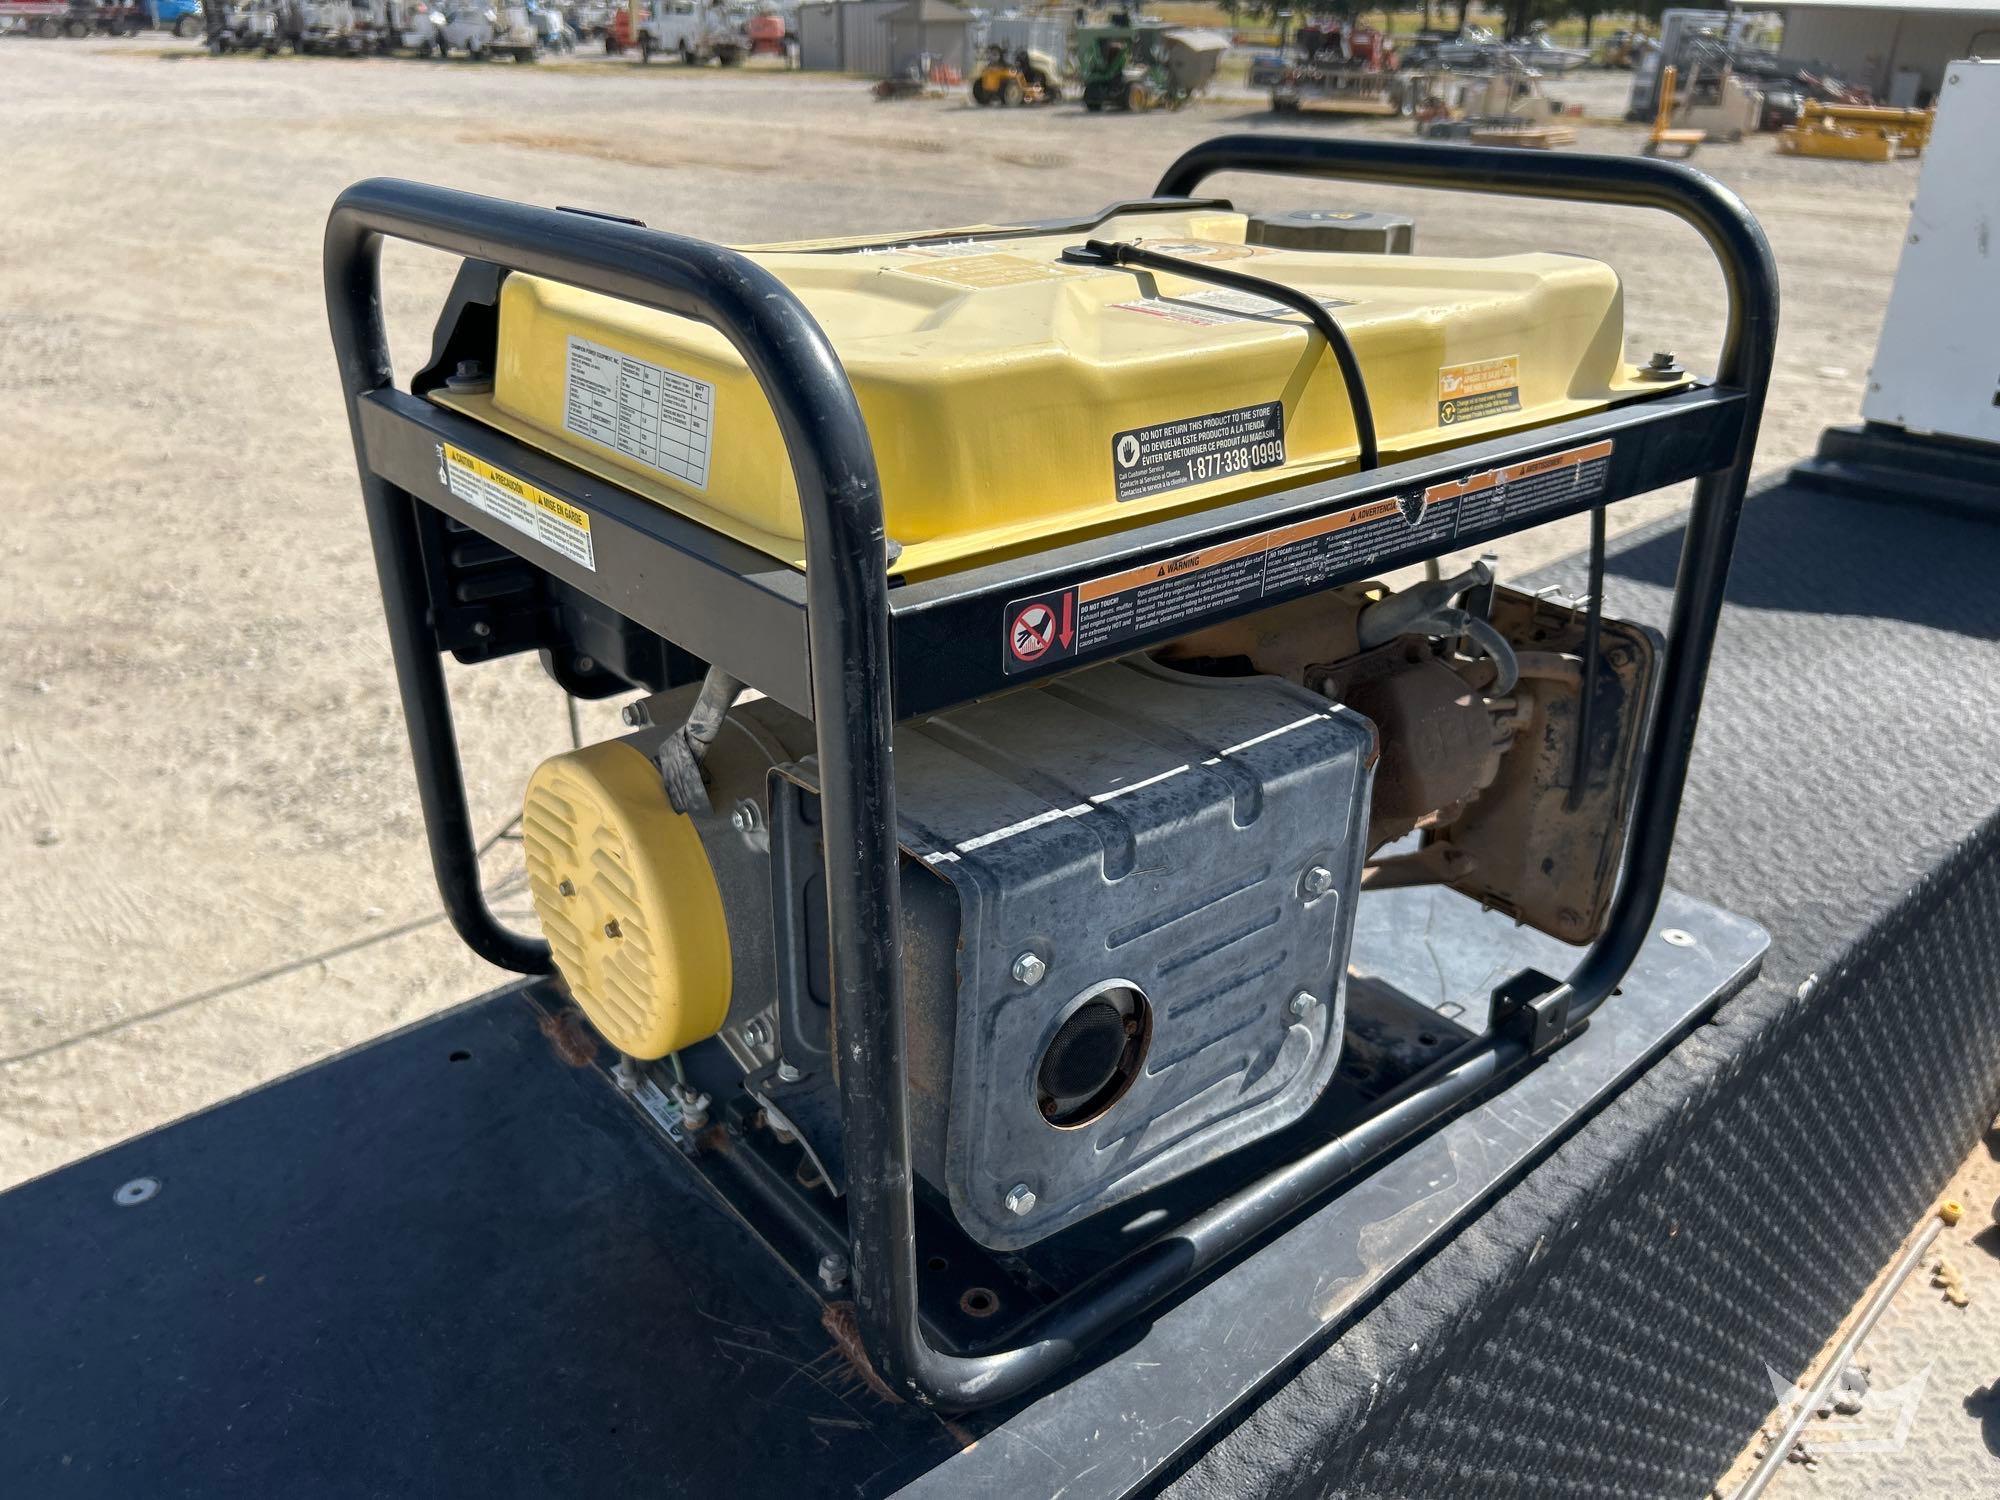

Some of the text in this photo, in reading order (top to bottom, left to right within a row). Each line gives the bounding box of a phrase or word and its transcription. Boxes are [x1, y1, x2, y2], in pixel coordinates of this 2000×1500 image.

[1140, 431, 1150, 441] DO
[1150, 428, 1162, 439] NOT
[1164, 423, 1188, 436] RETURN
[1189, 420, 1202, 431] THIS
[1203, 415, 1230, 428] PRODUCT
[1231, 413, 1239, 423] TO
[1240, 410, 1251, 421] THE
[1252, 406, 1270, 418] STORE
[1141, 419, 1264, 453] NO DEVUELVA ESTE PRODUCTO A LA TIENDA
[1142, 429, 1274, 465] ÉVITER DE RETOURNER CE PRODUIT AU MAGASIN
[1186, 439, 1283, 481] 1-877-338-0999
[1118, 464, 1164, 480] Call Customer Service
[1357, 499, 1396, 520] ADVERTENCIA
[1167, 556, 1199, 574] WARNING
[1137, 585, 1159, 597] Operation
[1221, 563, 1235, 573] sparks
[1147, 592, 1163, 602] around
[1163, 590, 1171, 598] dry
[1200, 578, 1212, 587] spark
[1080, 596, 1118, 613] DO NOT TOUCH!
[1157, 600, 1165, 608] The
[1166, 594, 1184, 605] operator
[1184, 590, 1199, 600] should
[1199, 585, 1215, 595] contact
[1216, 582, 1226, 590] local
[1080, 611, 1099, 622] Exhaust
[1146, 611, 1155, 619] and
[1172, 610, 1184, 619] every
[1185, 607, 1193, 615] 100
[1193, 603, 1206, 613] hours
[1211, 598, 1223, 607] every
[1079, 609, 1134, 631] and engine components
[1088, 624, 1110, 637] extremely
[1111, 621, 1121, 629] HOT
[1122, 618, 1130, 626] and
[1079, 638, 1092, 648] cause
